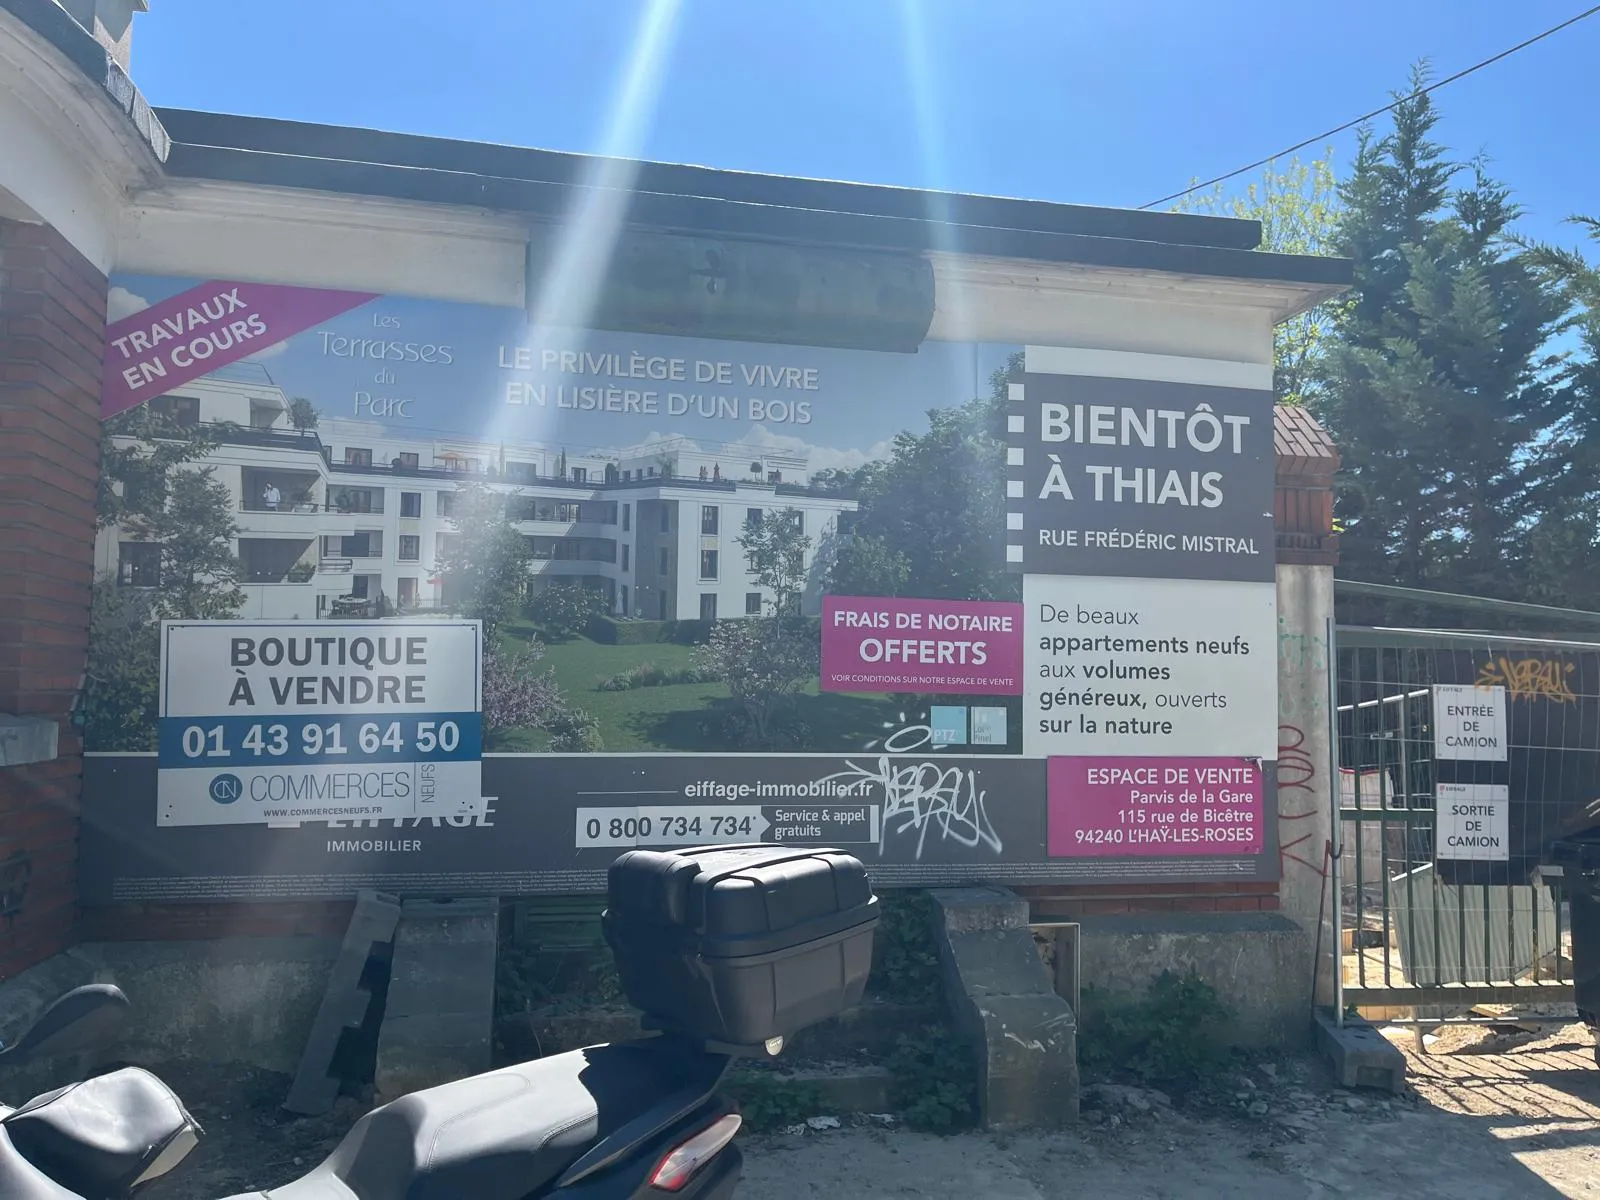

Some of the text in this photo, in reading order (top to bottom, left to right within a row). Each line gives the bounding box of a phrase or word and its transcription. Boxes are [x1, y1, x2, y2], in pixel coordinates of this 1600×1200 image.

[112, 288, 247, 359] TRAVAUX
[373, 312, 401, 328] Les
[122, 313, 267, 390] EN COURS
[317, 331, 454, 365] Terrasses
[374, 368, 396, 385] du
[499, 345, 819, 391] LE PRIVILÈGE DE VIVRE
[354, 391, 415, 418] Parc
[505, 382, 546, 406] EN
[557, 383, 659, 414] LISIÈRE
[750, 399, 812, 424] BOIS
[1041, 402, 1250, 454] BIENTÔT
[1038, 454, 1224, 508] À THIAIS
[1039, 528, 1259, 554] RUE FRÉDÉRIC MISTRAL
[834, 611, 1012, 632] FRAIS DE NOTAIRE
[1040, 604, 1139, 625] De beaux
[230, 637, 427, 671] BOUTIQUE
[859, 638, 987, 665] OFFERTS
[1039, 635, 1250, 655] appartements neufs
[1039, 659, 1170, 680] aux volumes
[228, 668, 426, 706] À VENDRE
[831, 674, 851, 682] VOIR
[851, 675, 901, 683] CONDITIONS
[919, 676, 945, 684] NOTRE
[947, 677, 975, 685] ESPACE
[989, 678, 1014, 686] VENTE
[1039, 687, 1227, 711] généreux, ouverts
[1447, 704, 1494, 717] ENTRÉE
[1039, 714, 1173, 734] sur la nature
[1463, 721, 1479, 732] DE
[182, 720, 460, 758] 01 43 91 64 50
[1445, 736, 1497, 748] CAMION
[250, 771, 410, 802] COMMERCES
[422, 763, 436, 803] NEUFS
[1087, 768, 1253, 785] ESPACE DE VENTE
[684, 781, 873, 800] eiffage-immobilier.fr
[1130, 789, 1253, 804] Parvis de la Gare
[263, 806, 382, 817] WWW.COMMERCESNEUFS.FR
[775, 809, 865, 824] Service & appel
[1118, 808, 1253, 823] 115 rue de Bicêtre
[1452, 805, 1495, 816] SORTIE
[586, 818, 600, 839] 0
[608, 816, 652, 838] 800
[659, 816, 702, 836] 734
[774, 825, 821, 841] gratuits
[1075, 829, 1123, 843] 94240
[1465, 821, 1482, 832] DE
[327, 840, 422, 852] IMMOBILIER
[1447, 836, 1499, 848] CAMION
